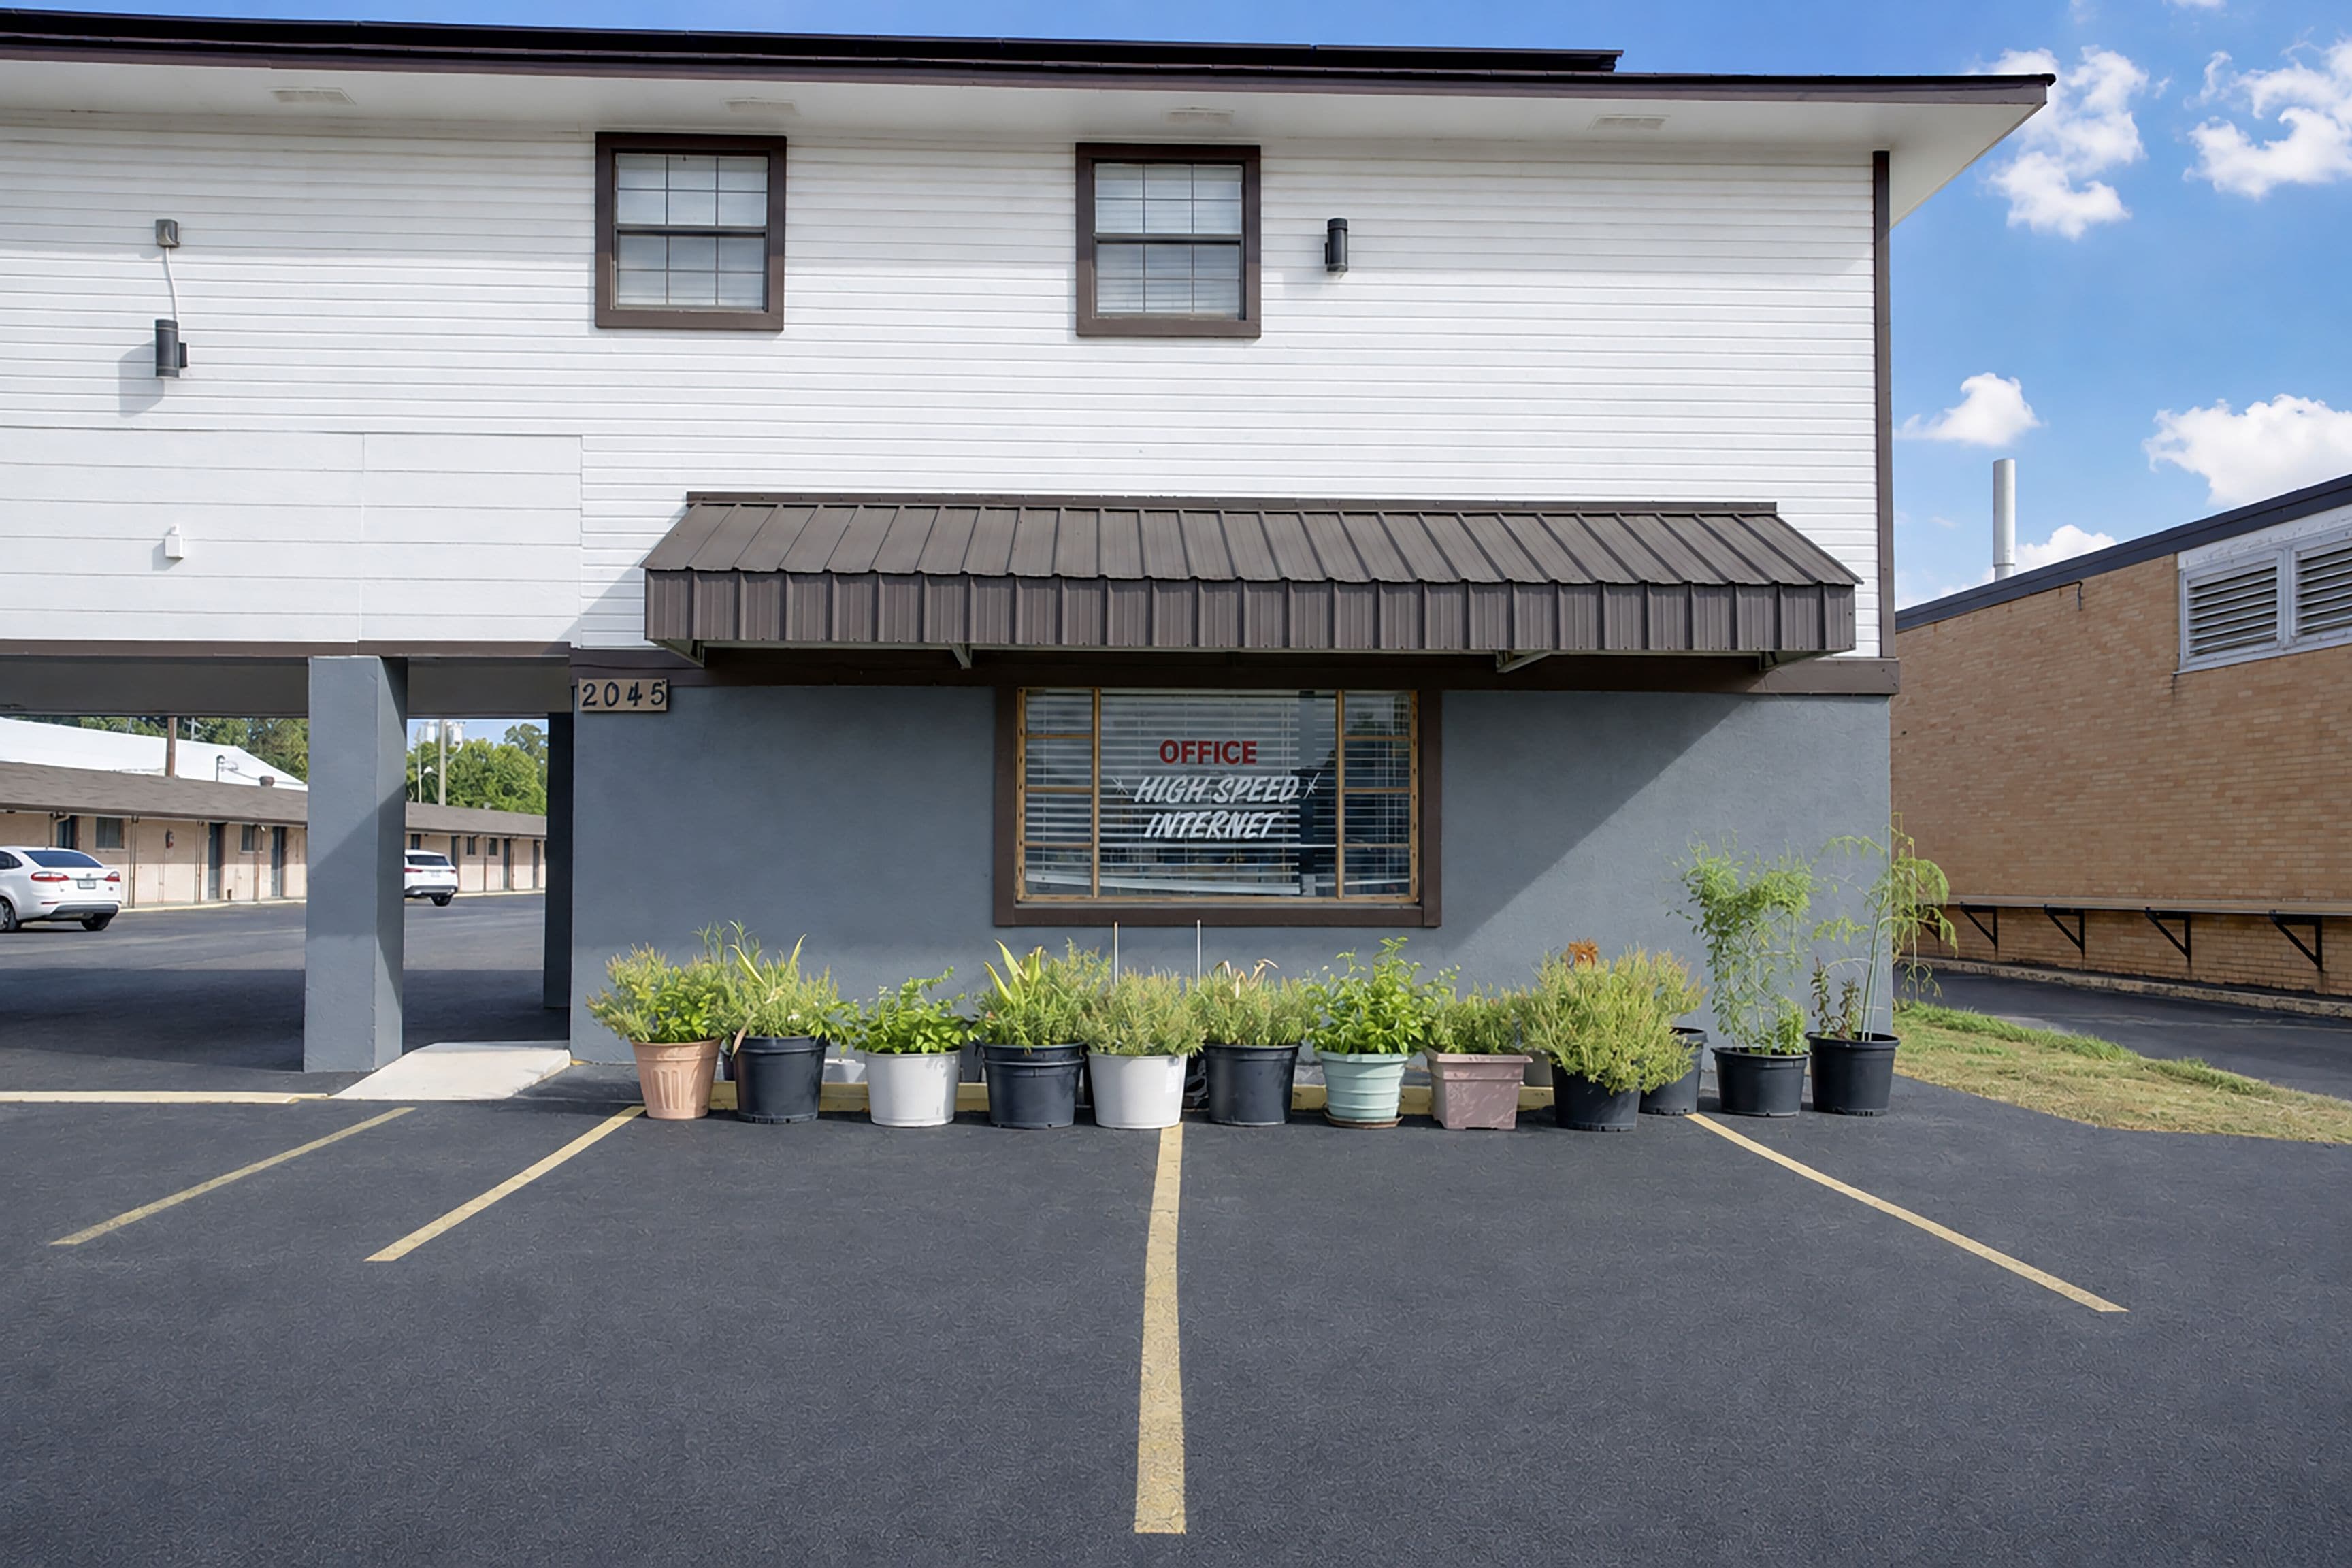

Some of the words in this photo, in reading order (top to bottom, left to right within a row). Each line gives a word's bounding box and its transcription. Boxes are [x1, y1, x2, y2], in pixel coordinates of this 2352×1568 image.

[582, 681, 665, 707] 2045
[1159, 739, 1257, 764] OFFICE
[1134, 775, 1213, 803] HIGH
[1212, 774, 1300, 803] SPEED
[1143, 810, 1282, 839] INTERNET
